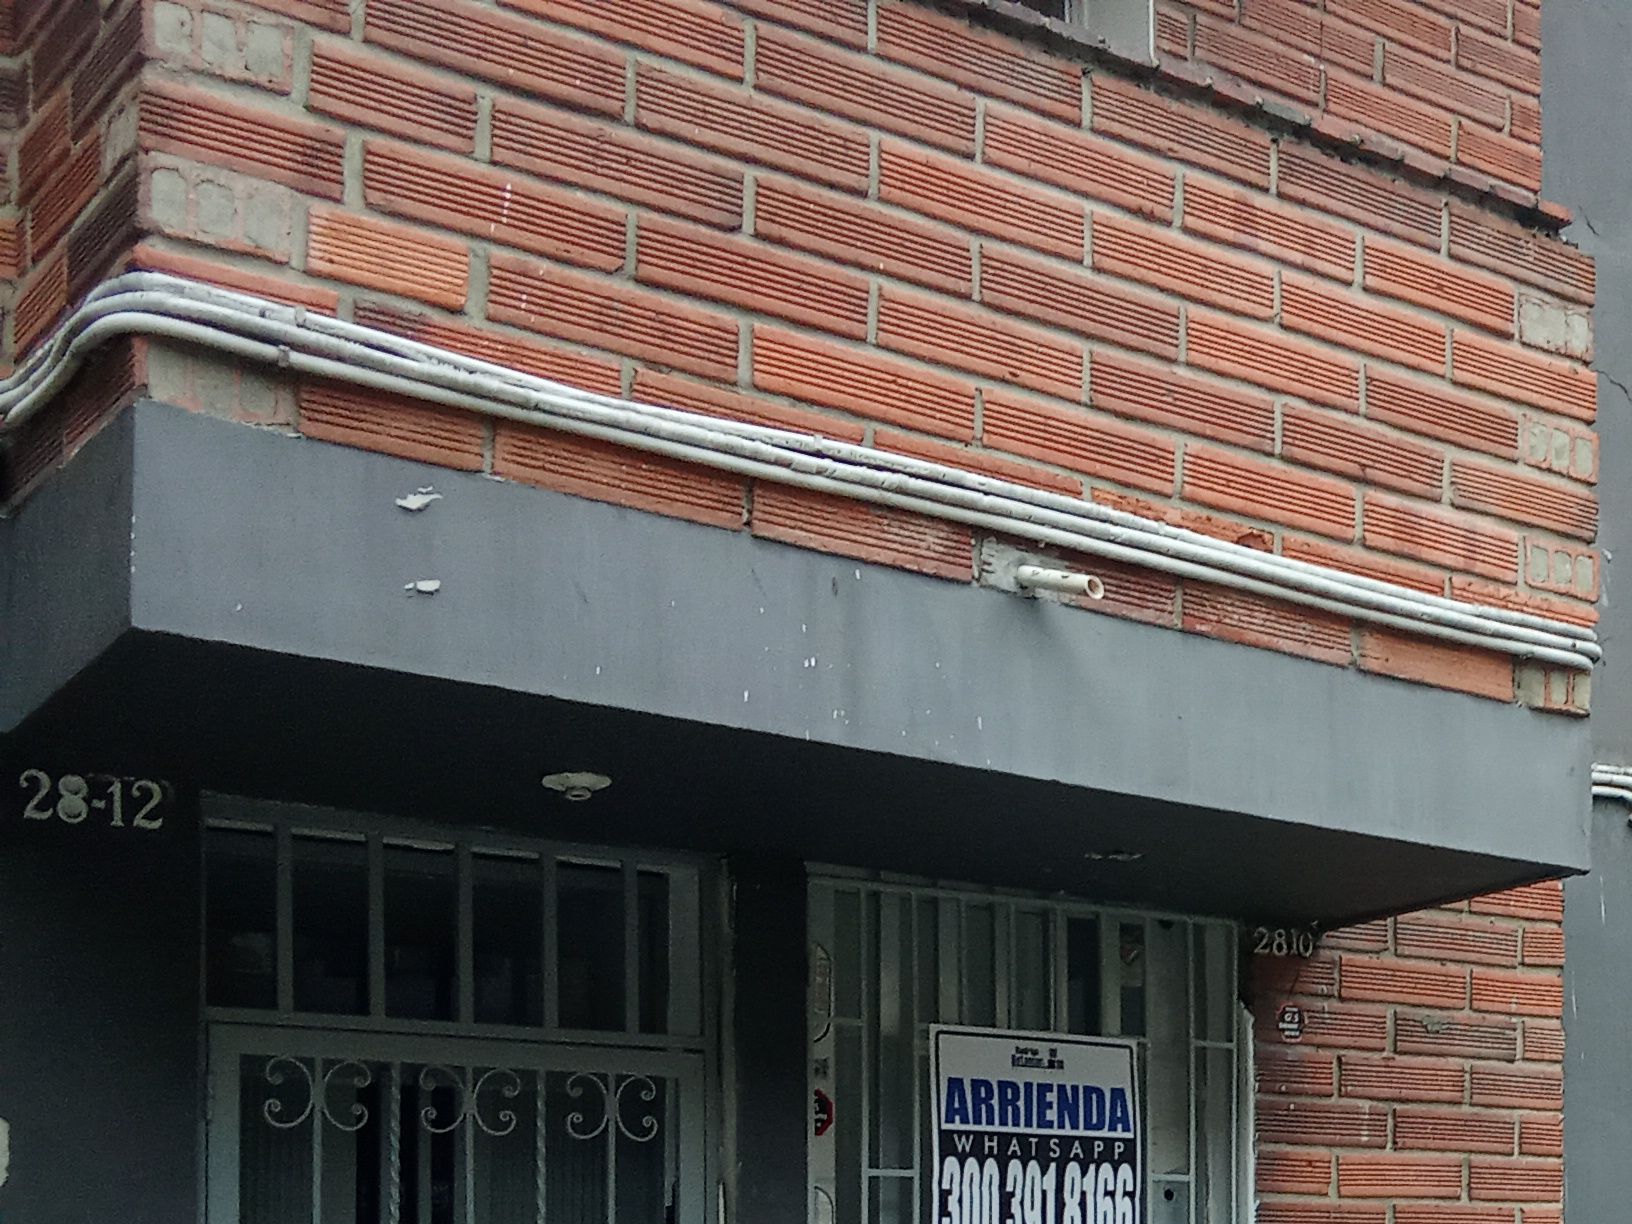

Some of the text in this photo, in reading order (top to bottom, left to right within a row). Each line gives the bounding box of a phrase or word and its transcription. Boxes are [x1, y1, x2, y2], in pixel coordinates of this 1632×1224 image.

[19, 768, 163, 829] 28-12
[944, 1076, 1132, 1133] ARRIENDA
[953, 1133, 1125, 1160] WHATSAPP
